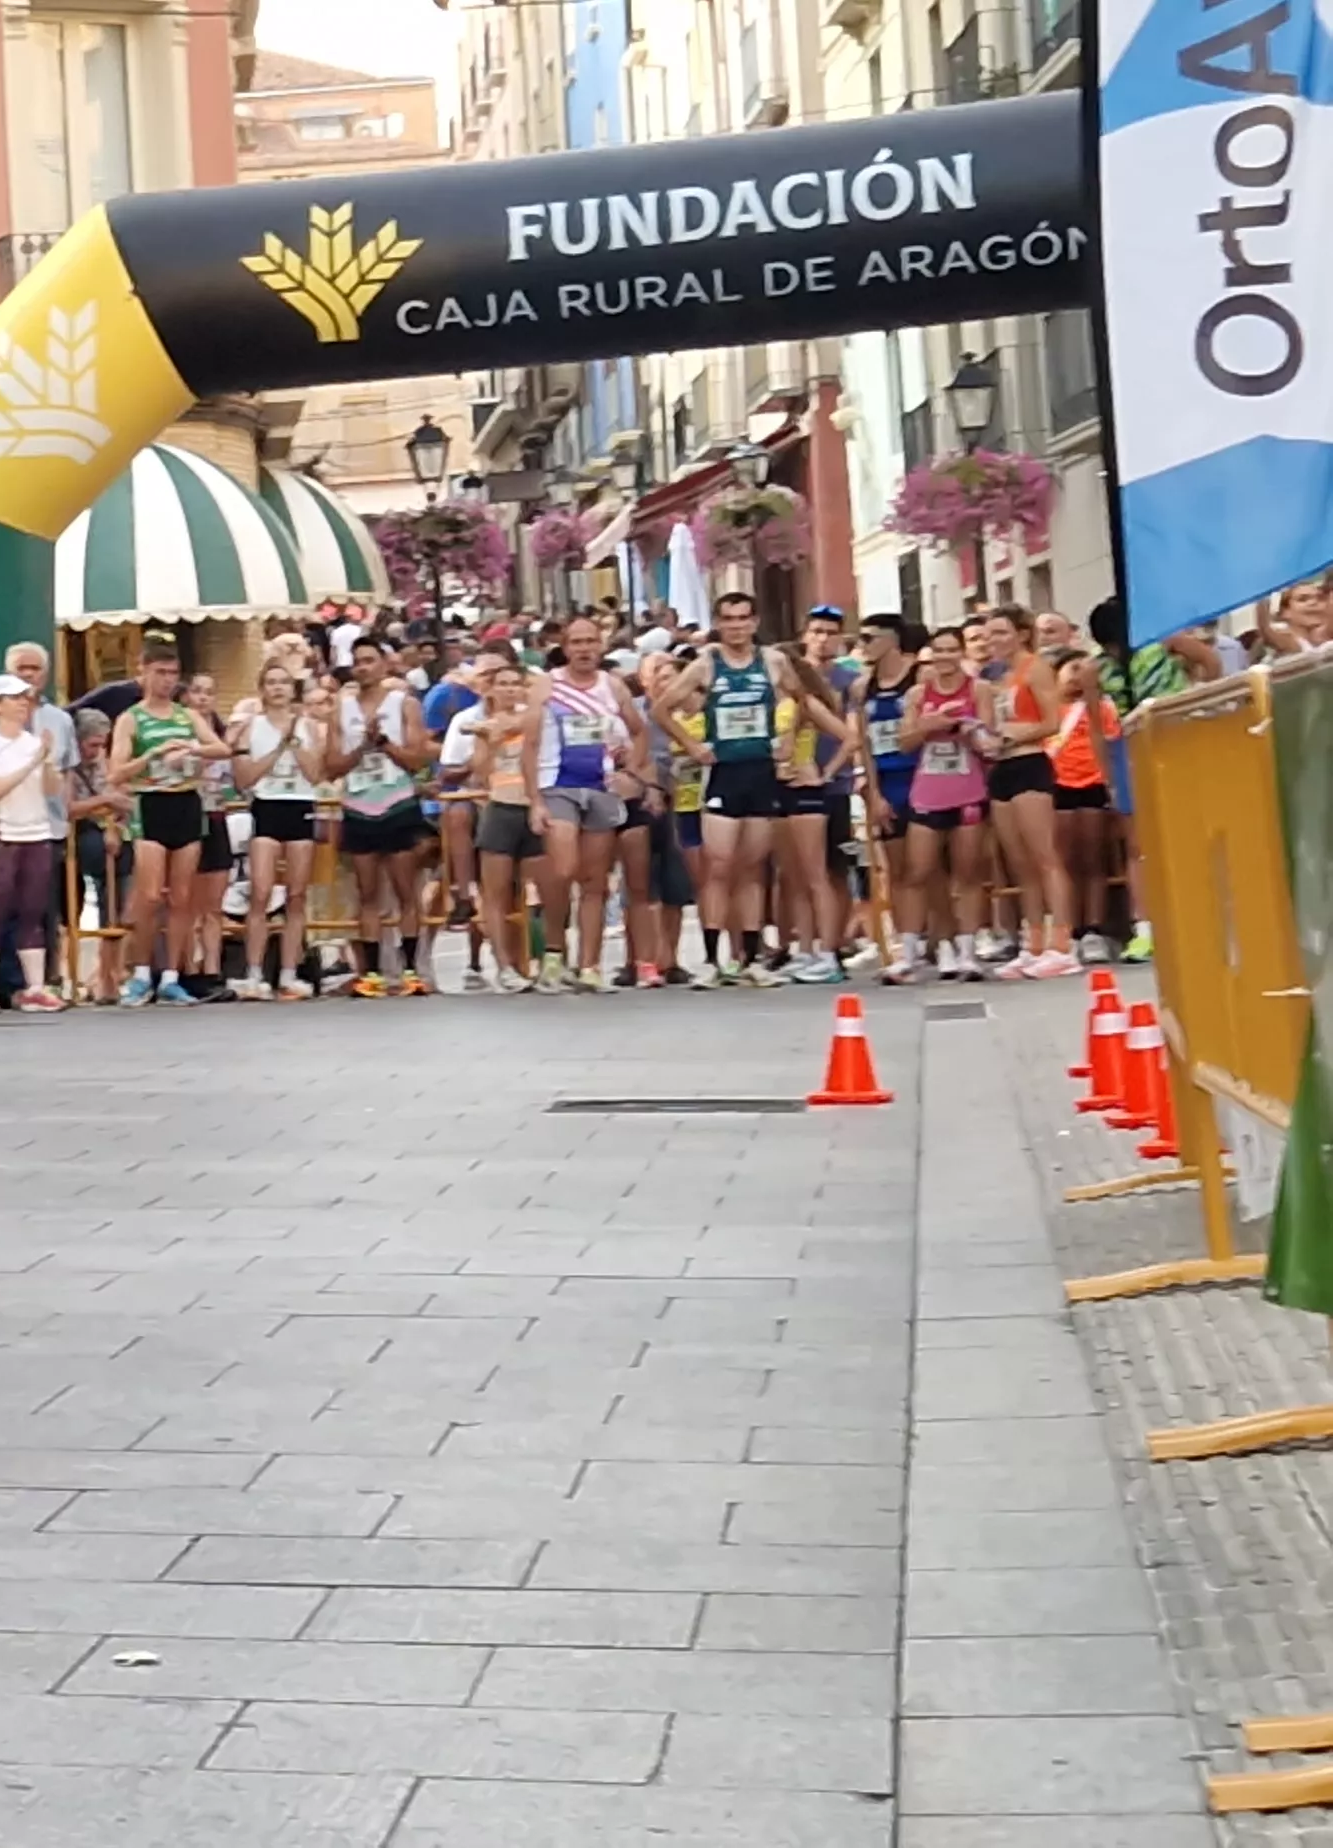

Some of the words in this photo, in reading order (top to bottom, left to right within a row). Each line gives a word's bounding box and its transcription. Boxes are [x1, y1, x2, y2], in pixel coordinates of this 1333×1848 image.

[507, 148, 977, 261] FUNDACIÓN
[1176, 0, 1303, 396] OrtoA
[396, 289, 538, 334] CAJA
[558, 266, 743, 318] RURAL
[764, 257, 835, 297] DE
